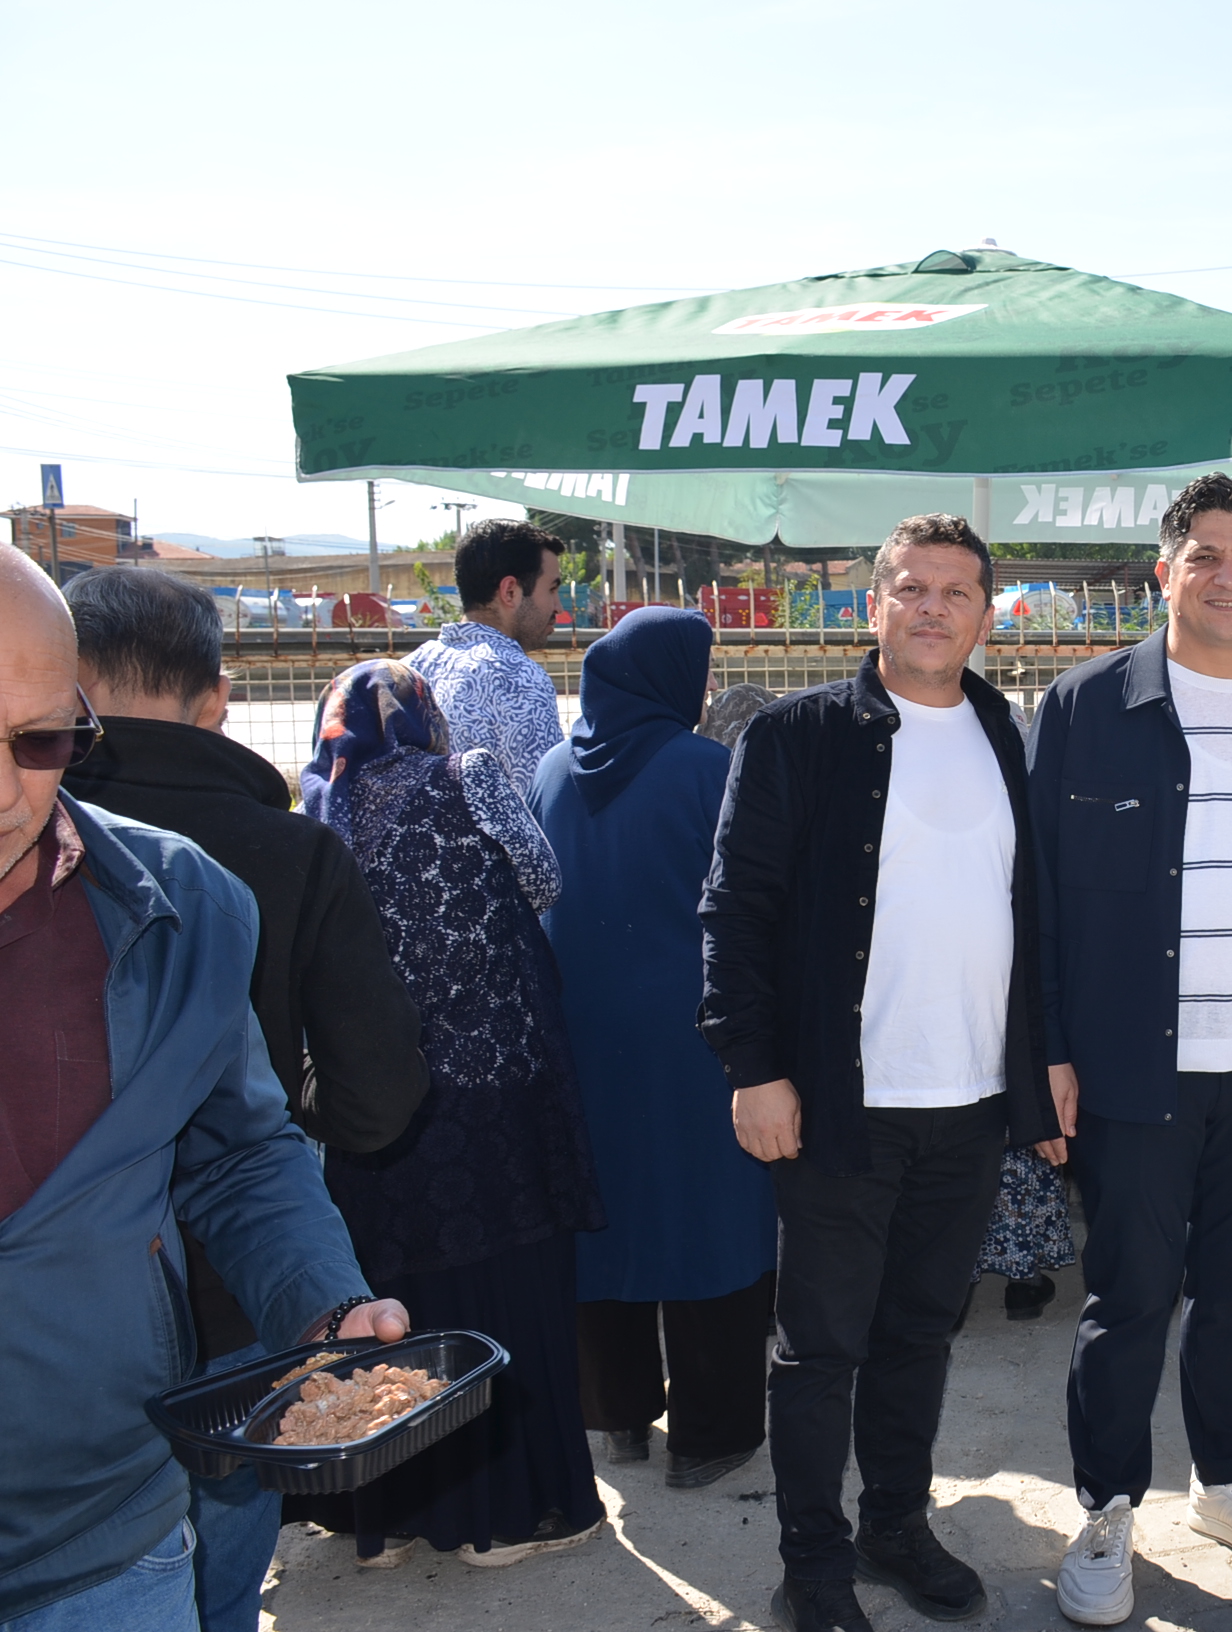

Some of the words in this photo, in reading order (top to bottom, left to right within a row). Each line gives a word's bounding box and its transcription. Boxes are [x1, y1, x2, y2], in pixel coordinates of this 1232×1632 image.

[734, 309, 951, 330] TAMEK
[403, 377, 520, 411] Sepete
[1009, 368, 1148, 407] Sepete
[632, 372, 917, 450] TAMEK
